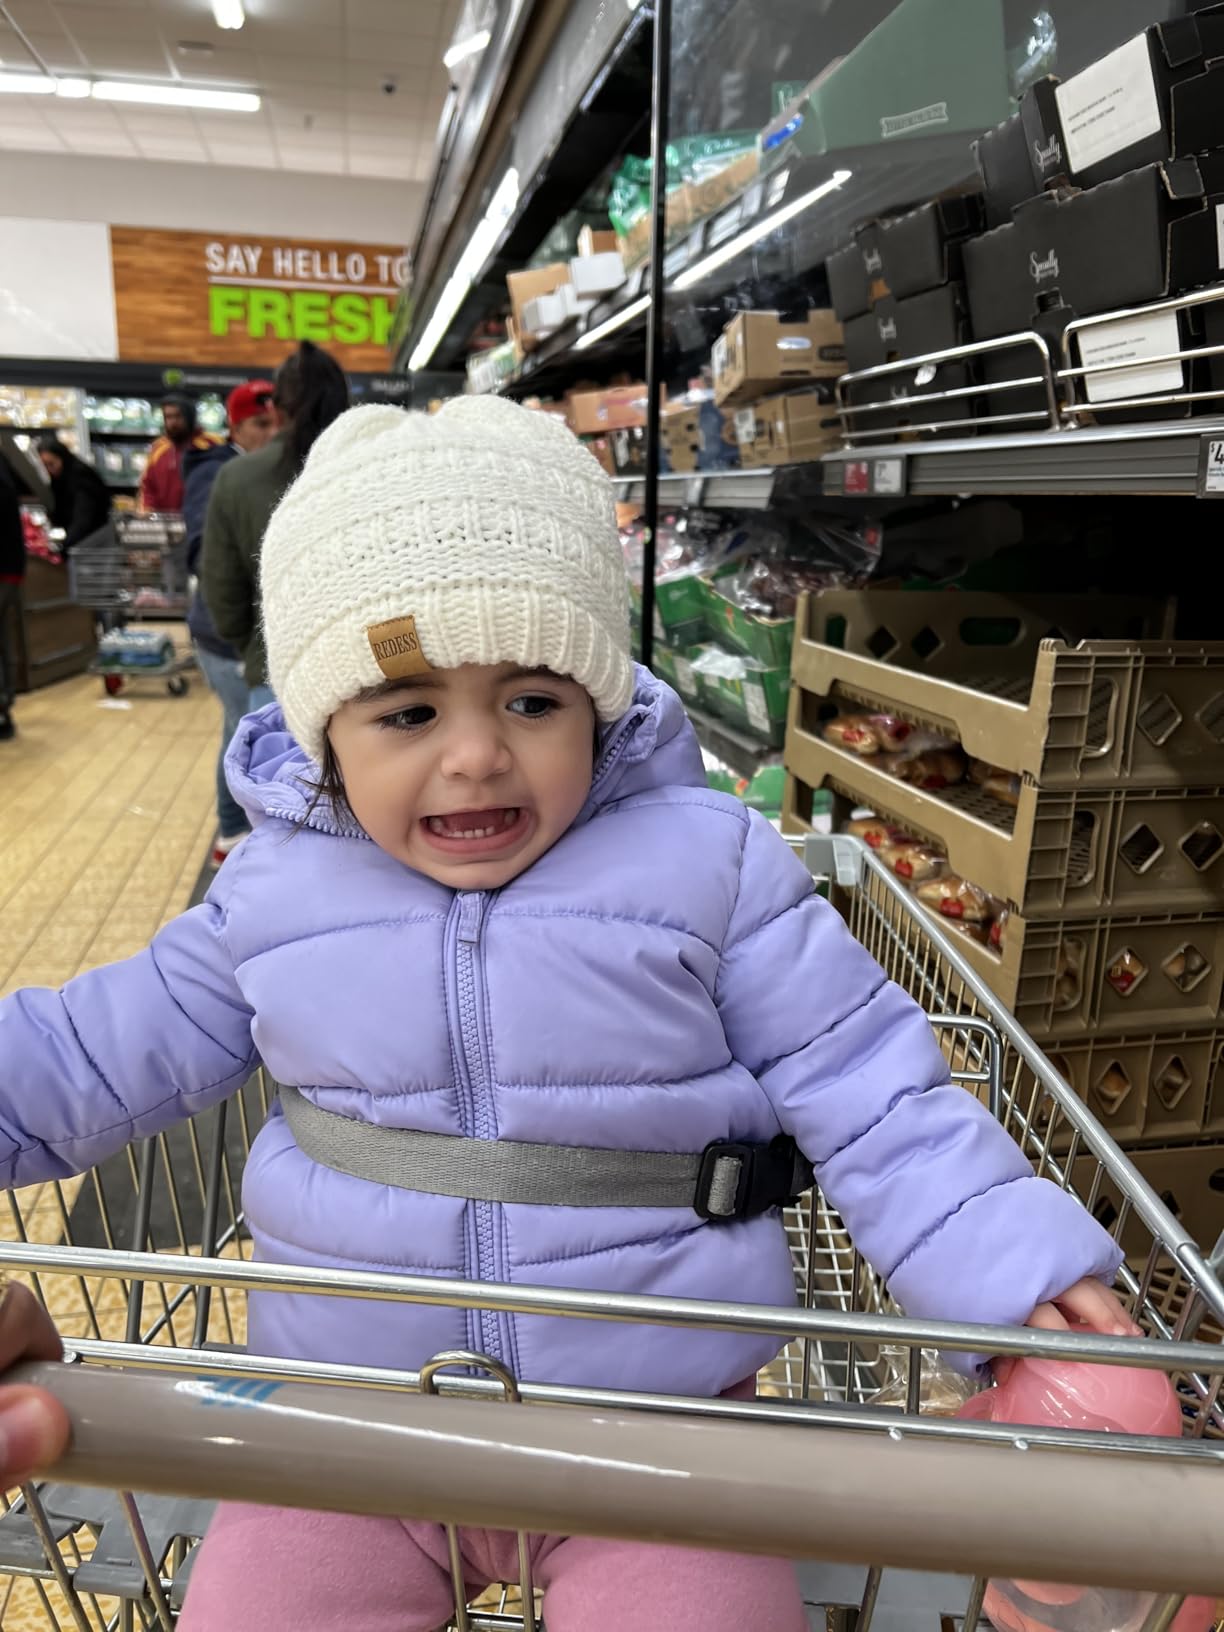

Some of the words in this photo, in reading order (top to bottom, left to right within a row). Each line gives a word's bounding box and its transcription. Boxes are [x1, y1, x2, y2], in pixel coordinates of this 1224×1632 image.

[206, 242, 262, 273] SAY
[272, 247, 366, 282] HELLO
[373, 632, 417, 660] REDESS
